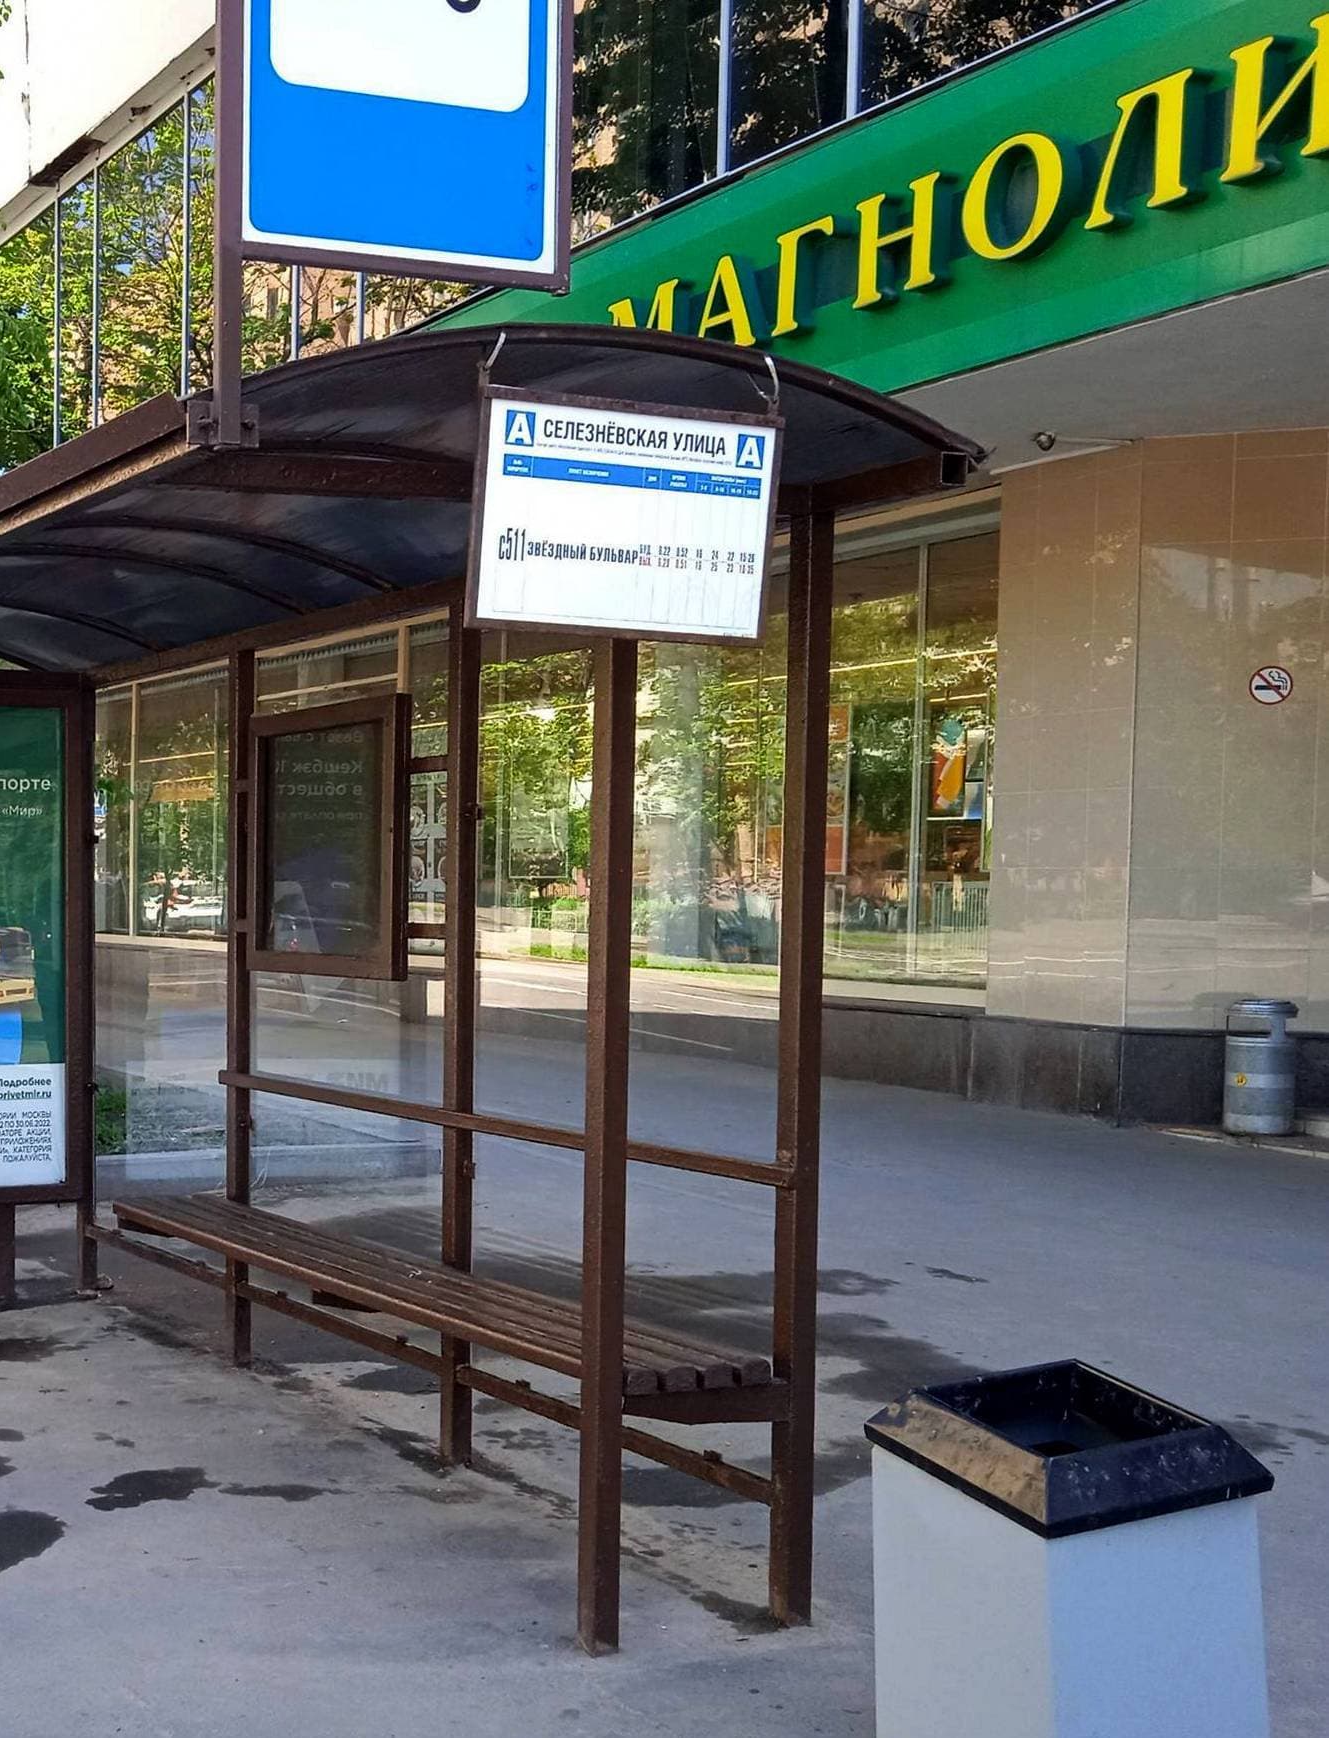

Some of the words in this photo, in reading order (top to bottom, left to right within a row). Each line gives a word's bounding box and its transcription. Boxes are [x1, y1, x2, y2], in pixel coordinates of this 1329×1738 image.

[543, 418, 668, 450] СЕЛЕЗНЁВСКАЯ
[673, 432, 726, 458] УЛИЦА
[498, 527, 526, 561] с511
[527, 540, 587, 560] ЗВЁЗДНЫЙ
[589, 546, 639, 564] БУЛЬВАР
[1, 805, 43, 818] «Мир»
[22, 1110, 52, 1119] МОСКВЫ
[4, 1121, 15, 1129] ПО
[0, 1136, 52, 1145] ПРИЛОЖЕНИЯХ
[13, 1144, 52, 1153] КАТЕГОРИЯ
